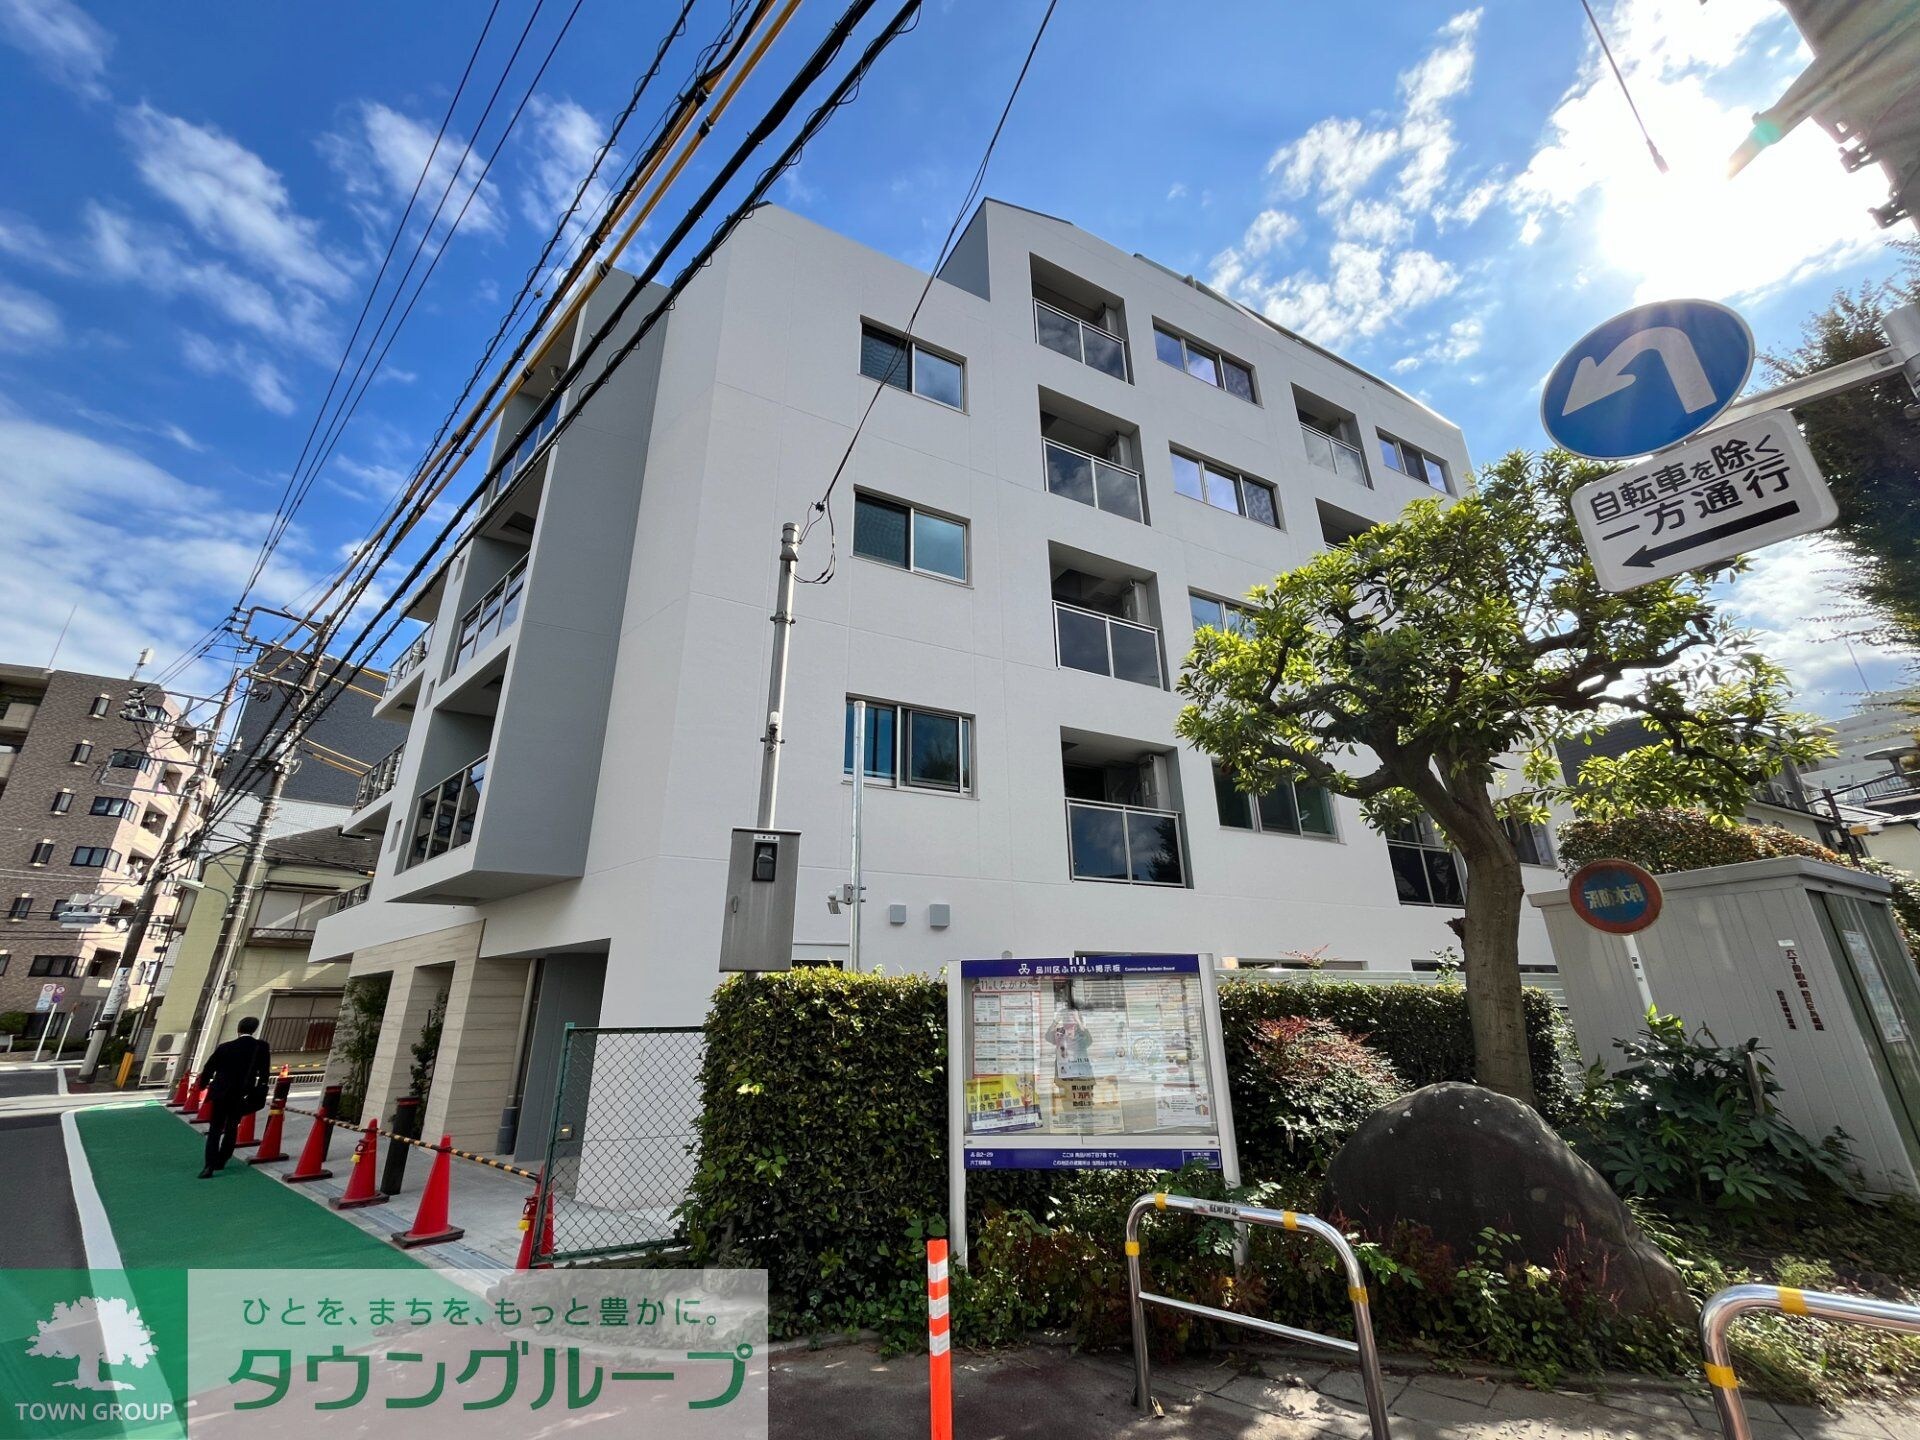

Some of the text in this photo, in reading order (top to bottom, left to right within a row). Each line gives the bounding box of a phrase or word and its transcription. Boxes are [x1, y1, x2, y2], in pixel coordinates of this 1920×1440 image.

[1590, 434, 1780, 521] 自転車を除く
[1602, 459, 1790, 542] 一方通行
[1036, 964, 1121, 974] 品川区ふれあい掲示板
